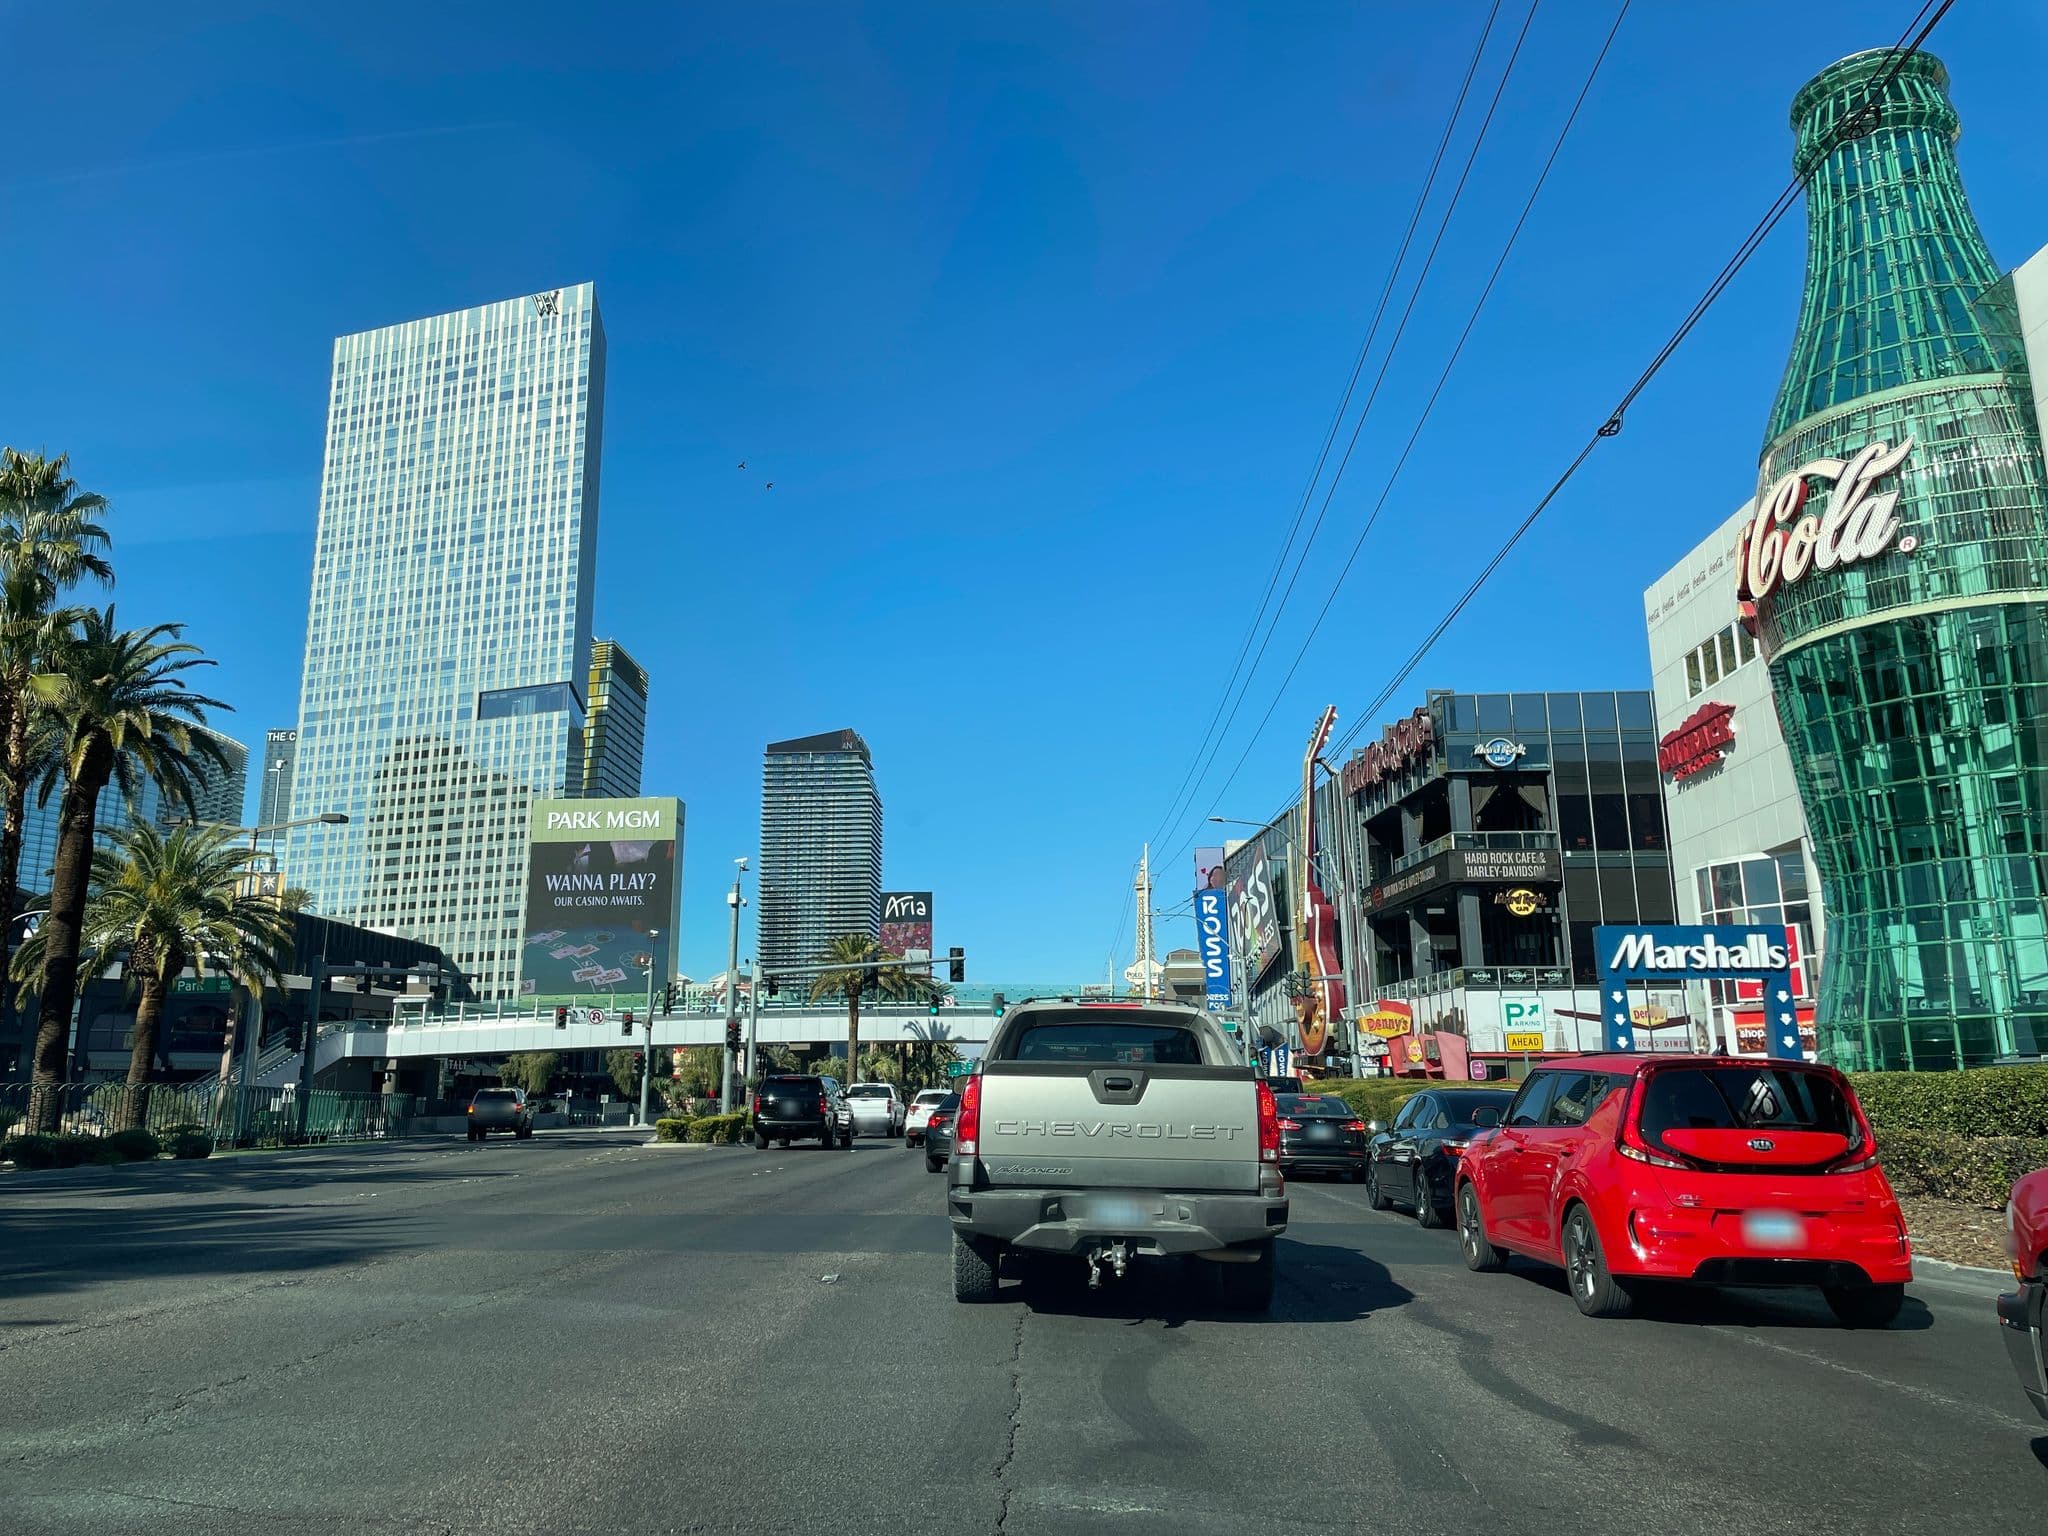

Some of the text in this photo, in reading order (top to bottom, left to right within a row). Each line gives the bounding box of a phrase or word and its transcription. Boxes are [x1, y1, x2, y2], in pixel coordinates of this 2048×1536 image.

[267, 732, 286, 741] THE
[547, 810, 661, 830] PARK MGM
[1464, 852, 1547, 864] HARD ROCK CAFE &
[1466, 866, 1546, 878] HARLEY-DAVIDSON
[545, 872, 657, 892] WANNA PLAY?
[554, 895, 646, 907] OUR CASINO AWAITS.
[885, 895, 926, 919] Aria
[1202, 895, 1224, 978] ROSS
[1610, 933, 1787, 969] Marshalls
[1367, 1016, 1409, 1032] Denny's
[1512, 1037, 1539, 1047] AHEAD
[1740, 1028, 1767, 1040] shop.
[1278, 1049, 1286, 1077] ROSS
[994, 1119, 1244, 1141] CHEVROLET
[1752, 1139, 1772, 1150] KIA
